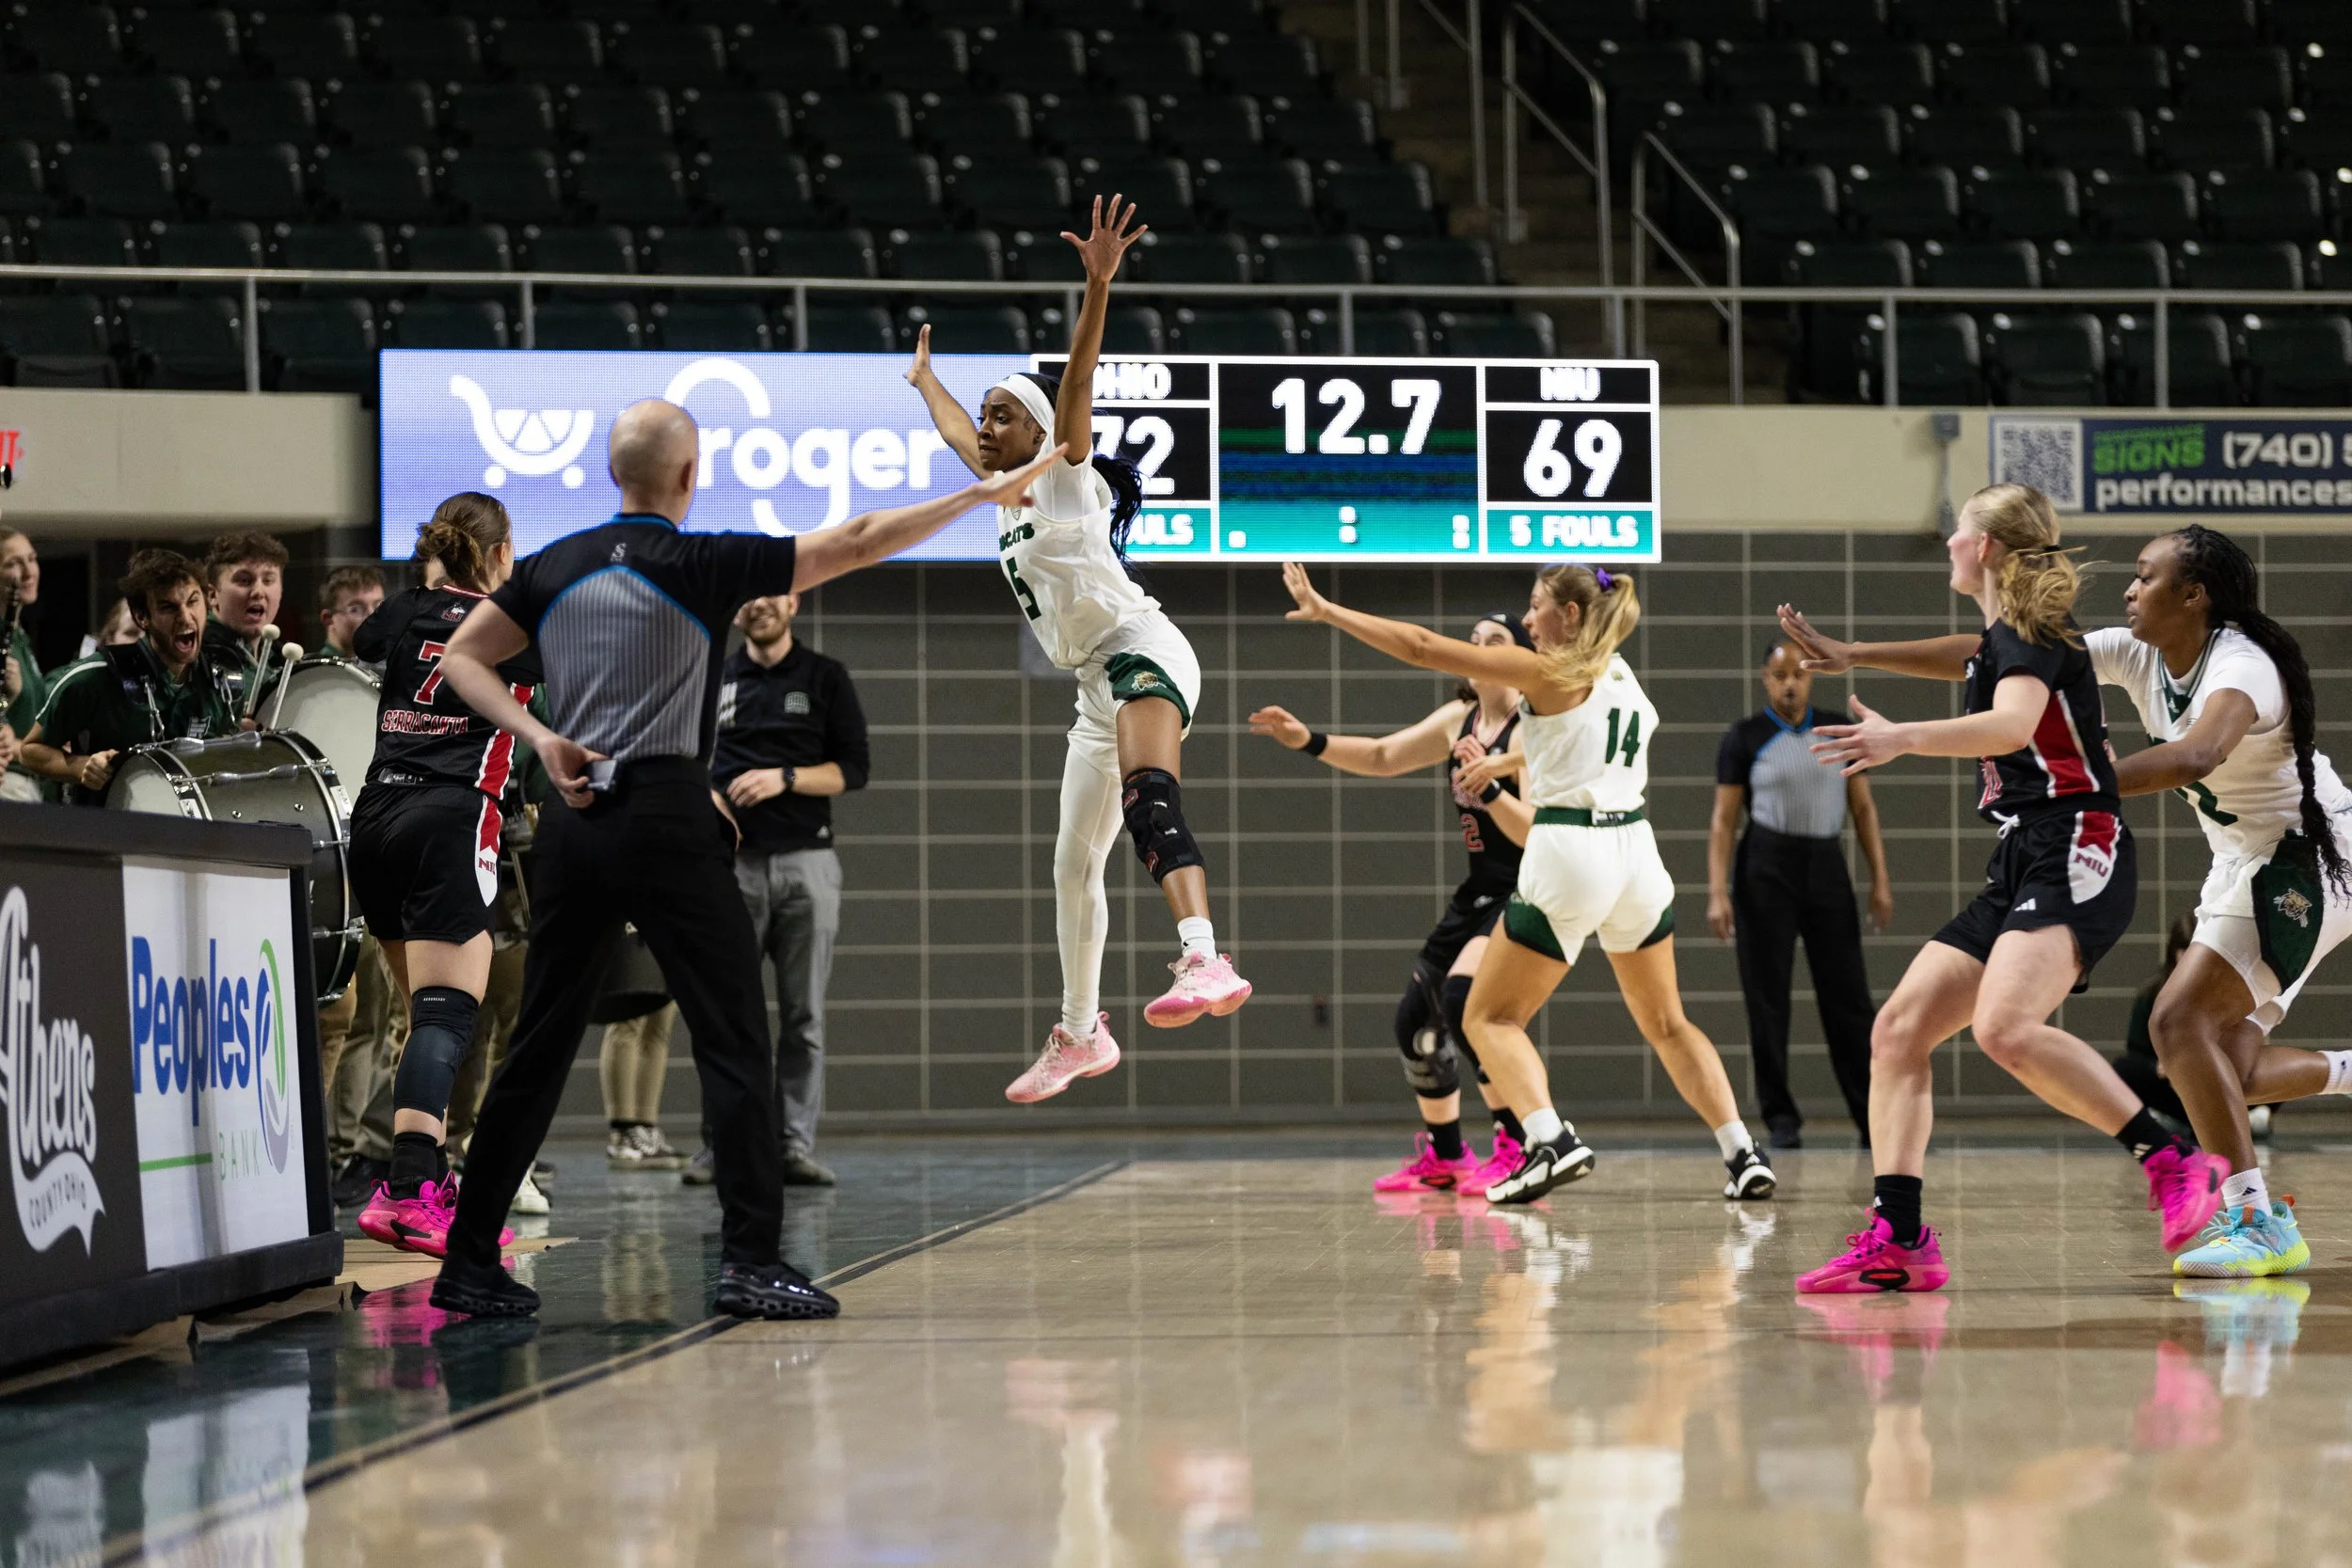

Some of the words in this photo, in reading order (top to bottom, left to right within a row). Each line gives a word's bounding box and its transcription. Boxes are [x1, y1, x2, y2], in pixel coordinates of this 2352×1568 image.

[1272, 378, 1441, 453] 12.7
[1091, 416, 1174, 495] 72
[1523, 419, 1623, 498] 69
[2092, 437, 2204, 474] SIGNS
[2222, 431, 2333, 469] (740)
[1126, 514, 1194, 546] ULS
[1509, 515, 1532, 546] 5
[1542, 515, 1639, 547] FOULS
[1006, 557, 1041, 621] 5
[414, 640, 447, 705] 7
[1604, 707, 1640, 768] 14
[1460, 813, 1485, 853] 2
[2074, 851, 2109, 878] NIU
[132, 936, 250, 1127] Peoples
[218, 1128, 261, 1180] BANK
[29, 1178, 62, 1230] COUNTY
